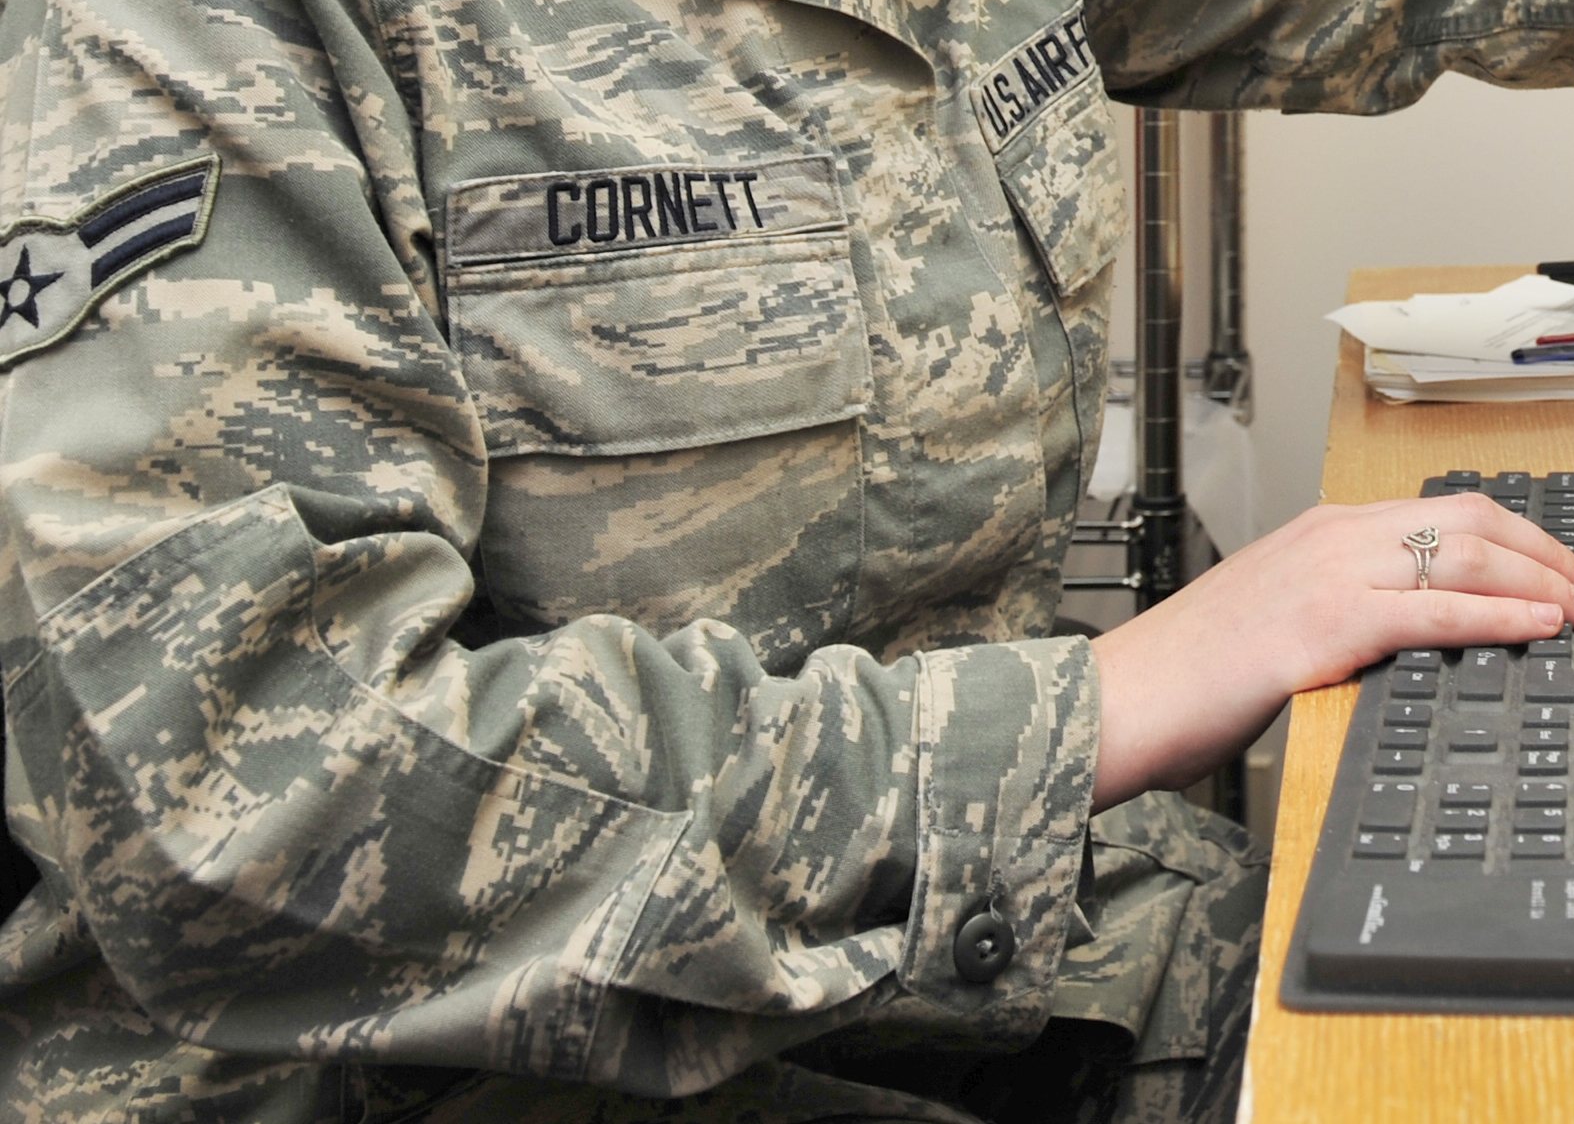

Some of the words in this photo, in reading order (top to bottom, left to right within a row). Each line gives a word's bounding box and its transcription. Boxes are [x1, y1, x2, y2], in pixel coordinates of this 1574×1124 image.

[1012, 34, 1079, 106] AIR
[1063, 9, 1089, 68] F
[547, 172, 764, 246] CORNETT
[1542, 834, 1561, 842] 6
